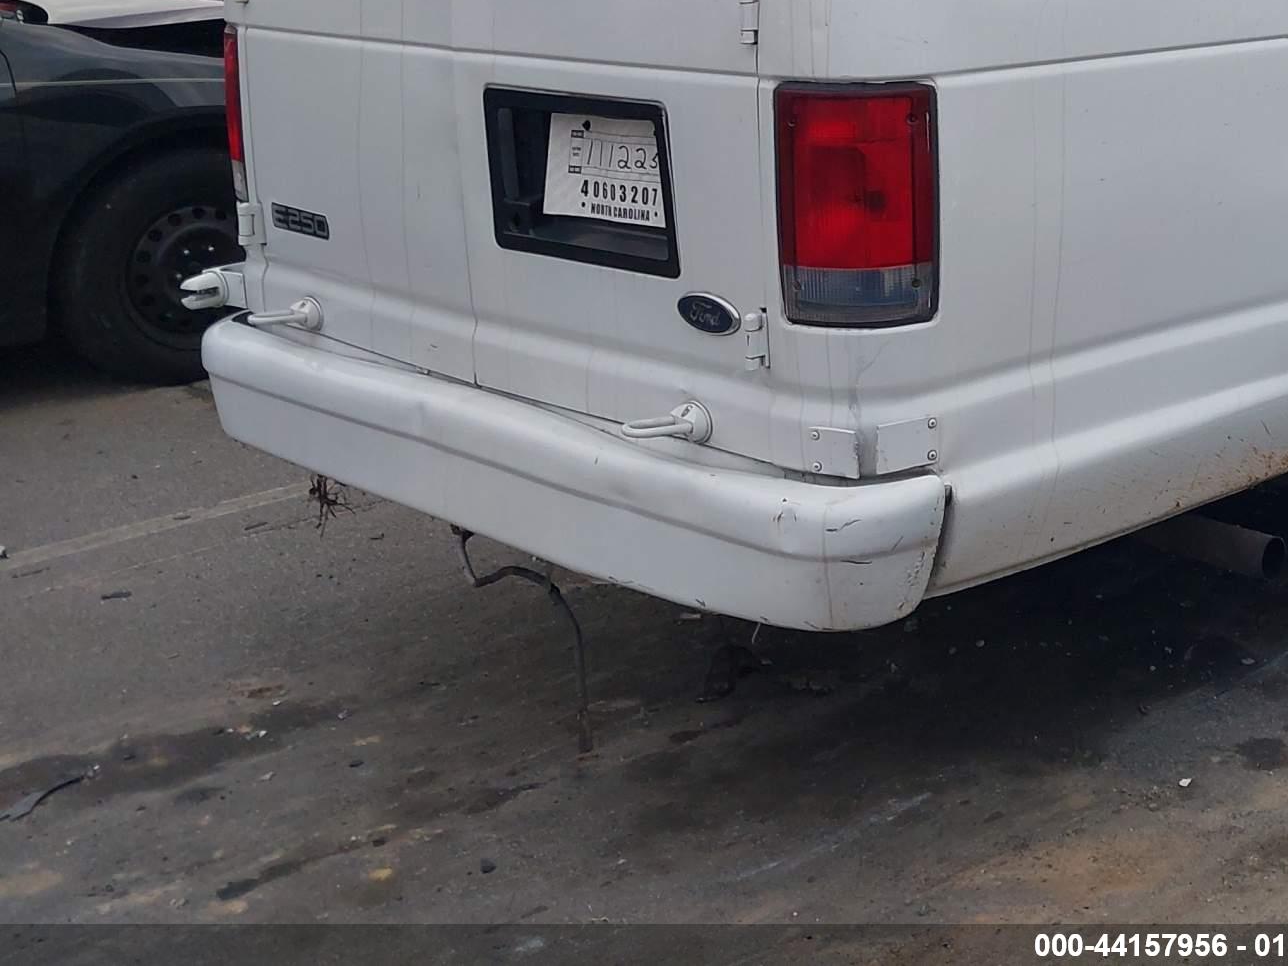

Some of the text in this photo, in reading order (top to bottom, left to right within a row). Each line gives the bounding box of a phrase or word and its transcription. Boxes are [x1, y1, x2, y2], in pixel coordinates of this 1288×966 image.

[580, 179, 658, 206] 40603207
[590, 202, 650, 222] NORTH CAROLINA
[689, 301, 721, 326] Ford
